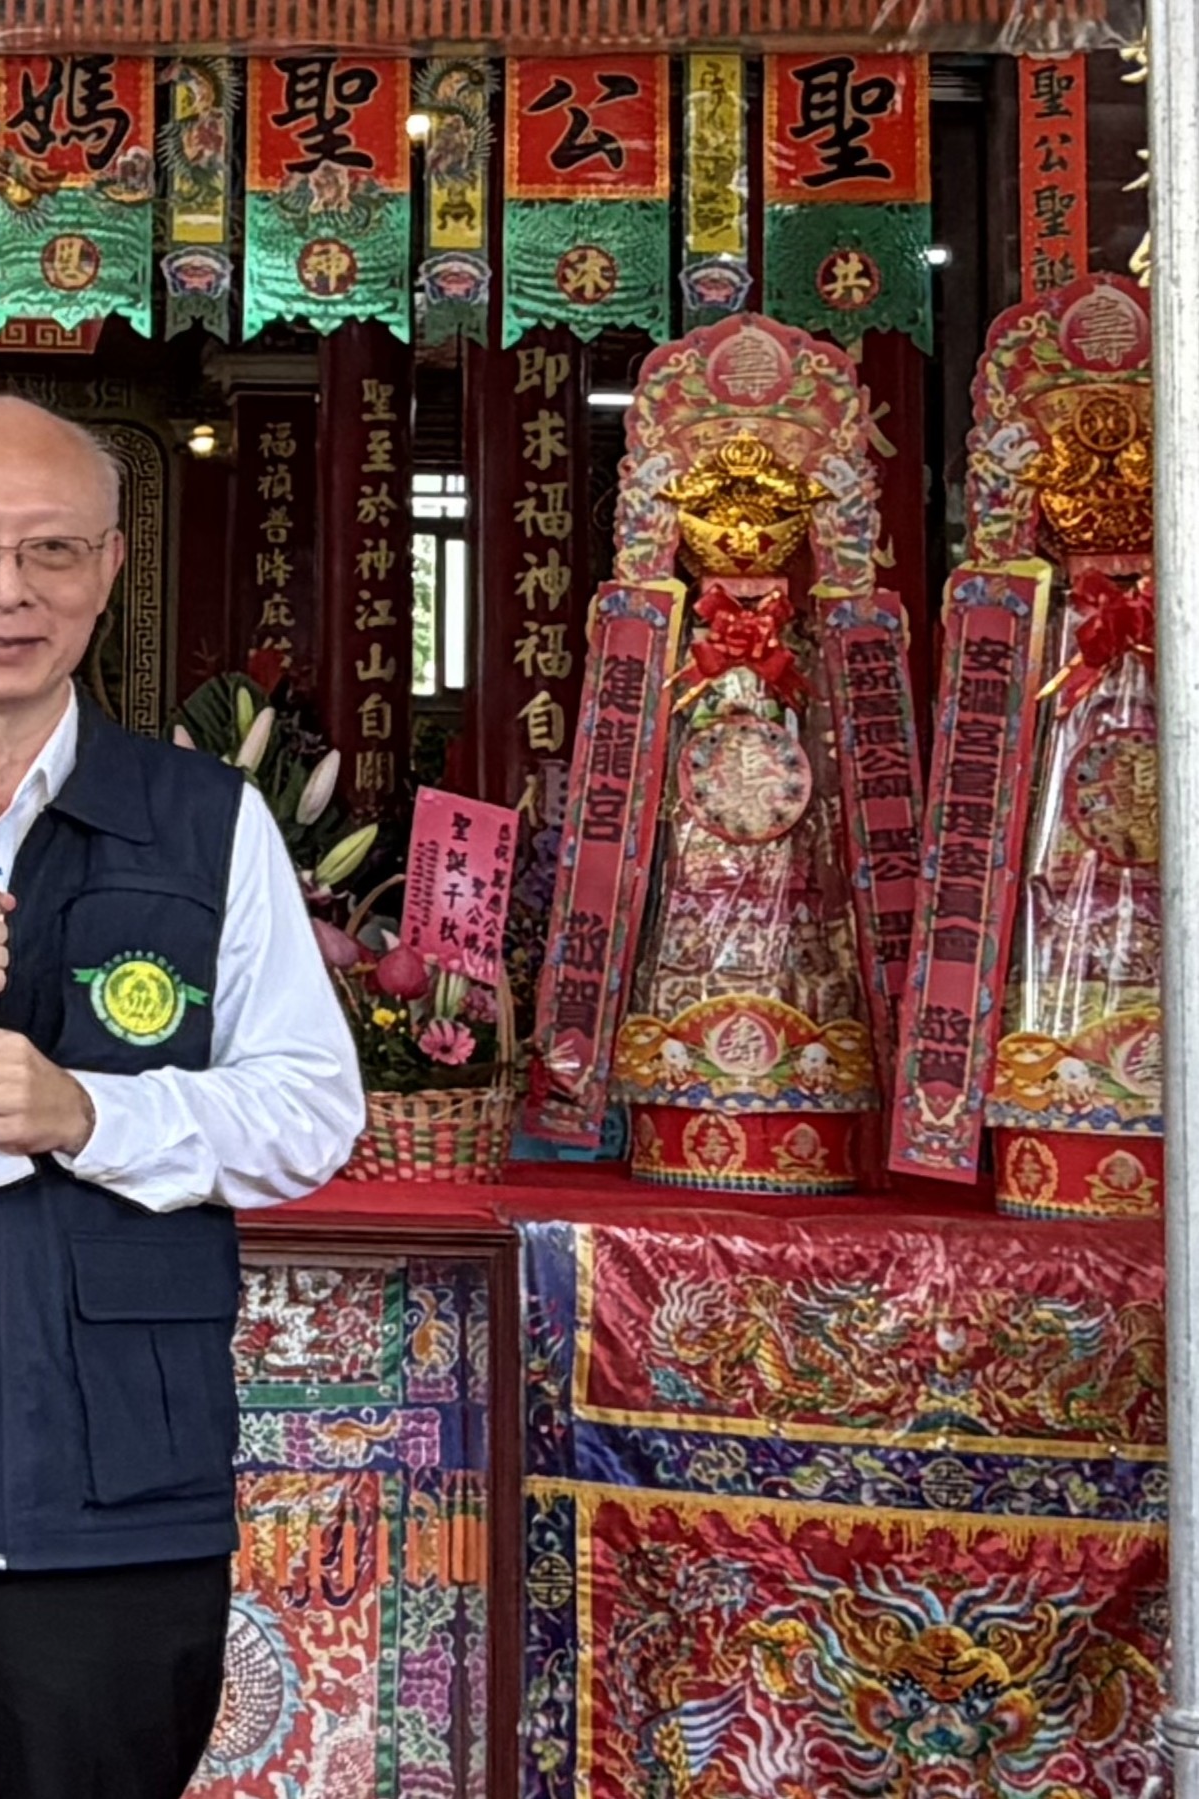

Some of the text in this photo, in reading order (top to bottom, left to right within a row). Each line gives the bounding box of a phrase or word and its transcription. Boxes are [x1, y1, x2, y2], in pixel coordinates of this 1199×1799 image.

[1030, 64, 1075, 291] 聖公聖誕
[439, 811, 474, 947] 聖誕千秋
